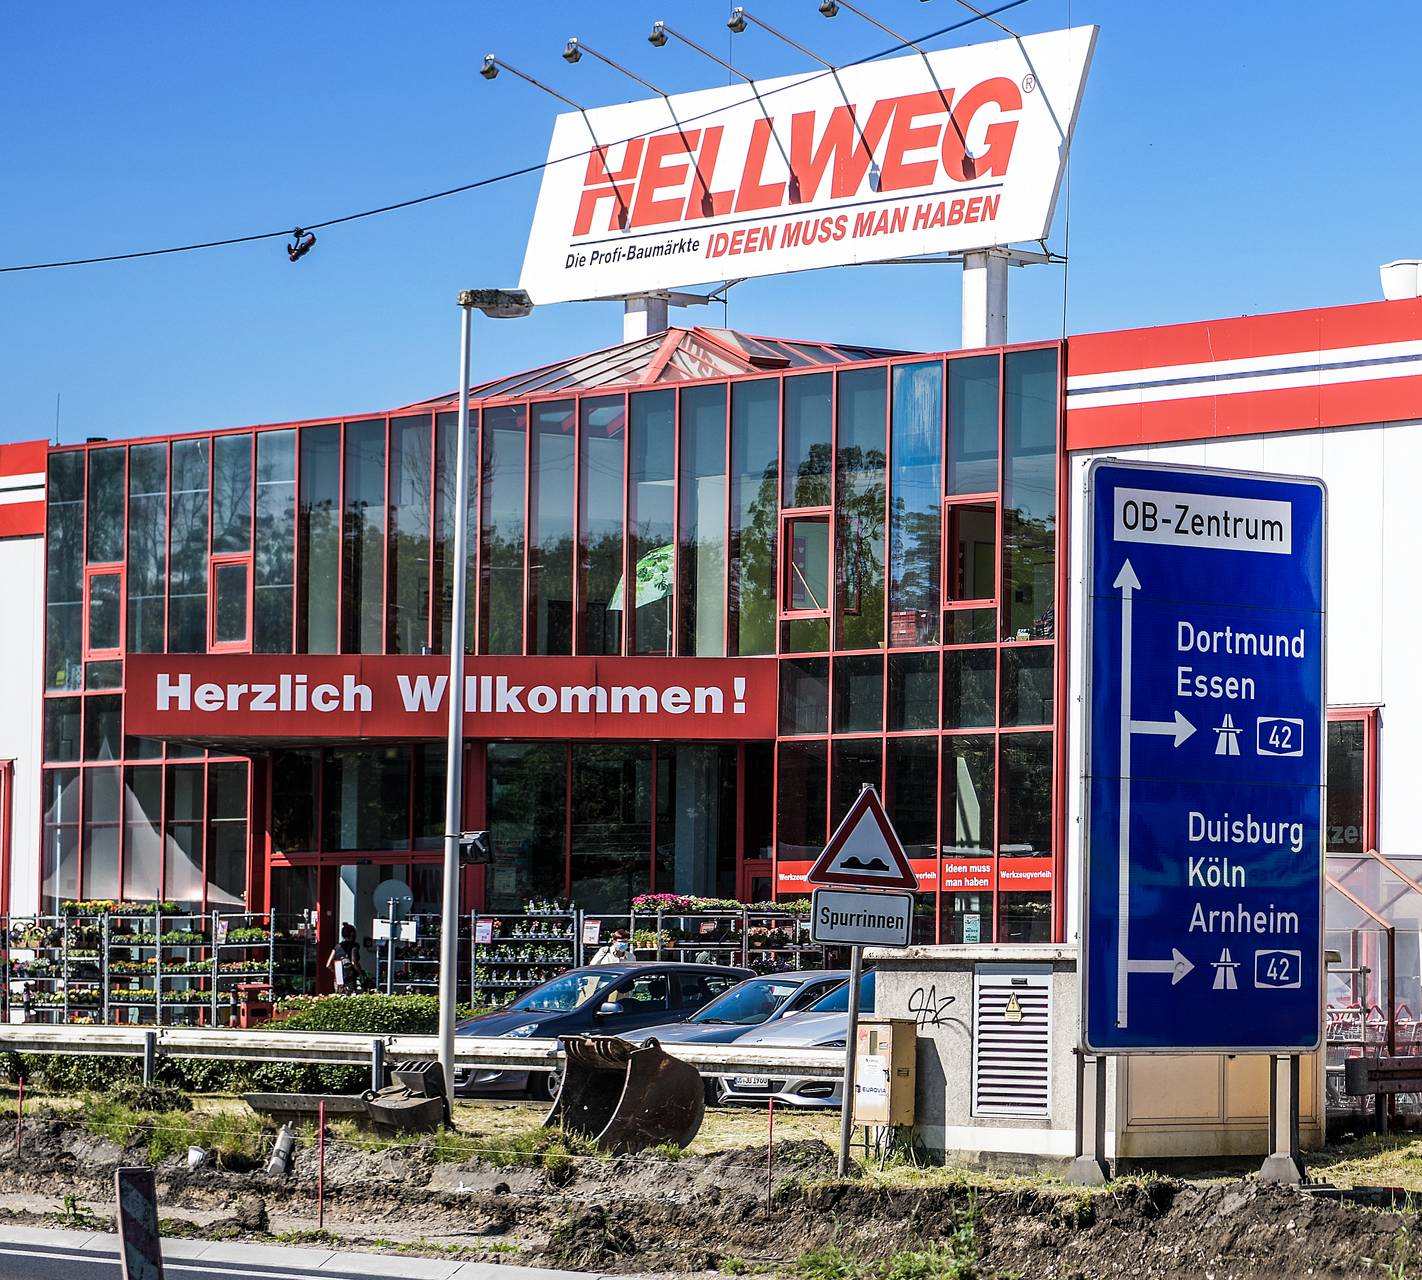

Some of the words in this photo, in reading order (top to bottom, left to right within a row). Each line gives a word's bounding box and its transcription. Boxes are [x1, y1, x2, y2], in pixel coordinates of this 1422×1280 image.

[572, 77, 1022, 236] HELLWEG
[565, 254, 587, 269] Die
[590, 237, 700, 266] Profi-Baumärkte
[705, 225, 778, 259] IDEEN
[780, 214, 849, 249] MUSS
[852, 207, 910, 239] MAN
[912, 194, 1001, 231] HABEN
[1122, 500, 1283, 542] OB-Zentrum
[1177, 620, 1305, 658] Dortmund
[156, 673, 373, 712] Herzlich
[396, 675, 746, 714] Wllkommen!
[1177, 666, 1255, 700] Essen
[1268, 725, 1292, 749] 42
[1188, 811, 1303, 853] Duisburg
[945, 863, 968, 874] Ideen
[970, 865, 991, 873] muss
[945, 879, 962, 887] man
[964, 877, 989, 887] haben
[1188, 856, 1246, 887] Köln
[821, 906, 904, 930] Spurrinnen
[1188, 902, 1298, 933] Arnheim
[1267, 958, 1290, 981] 42
